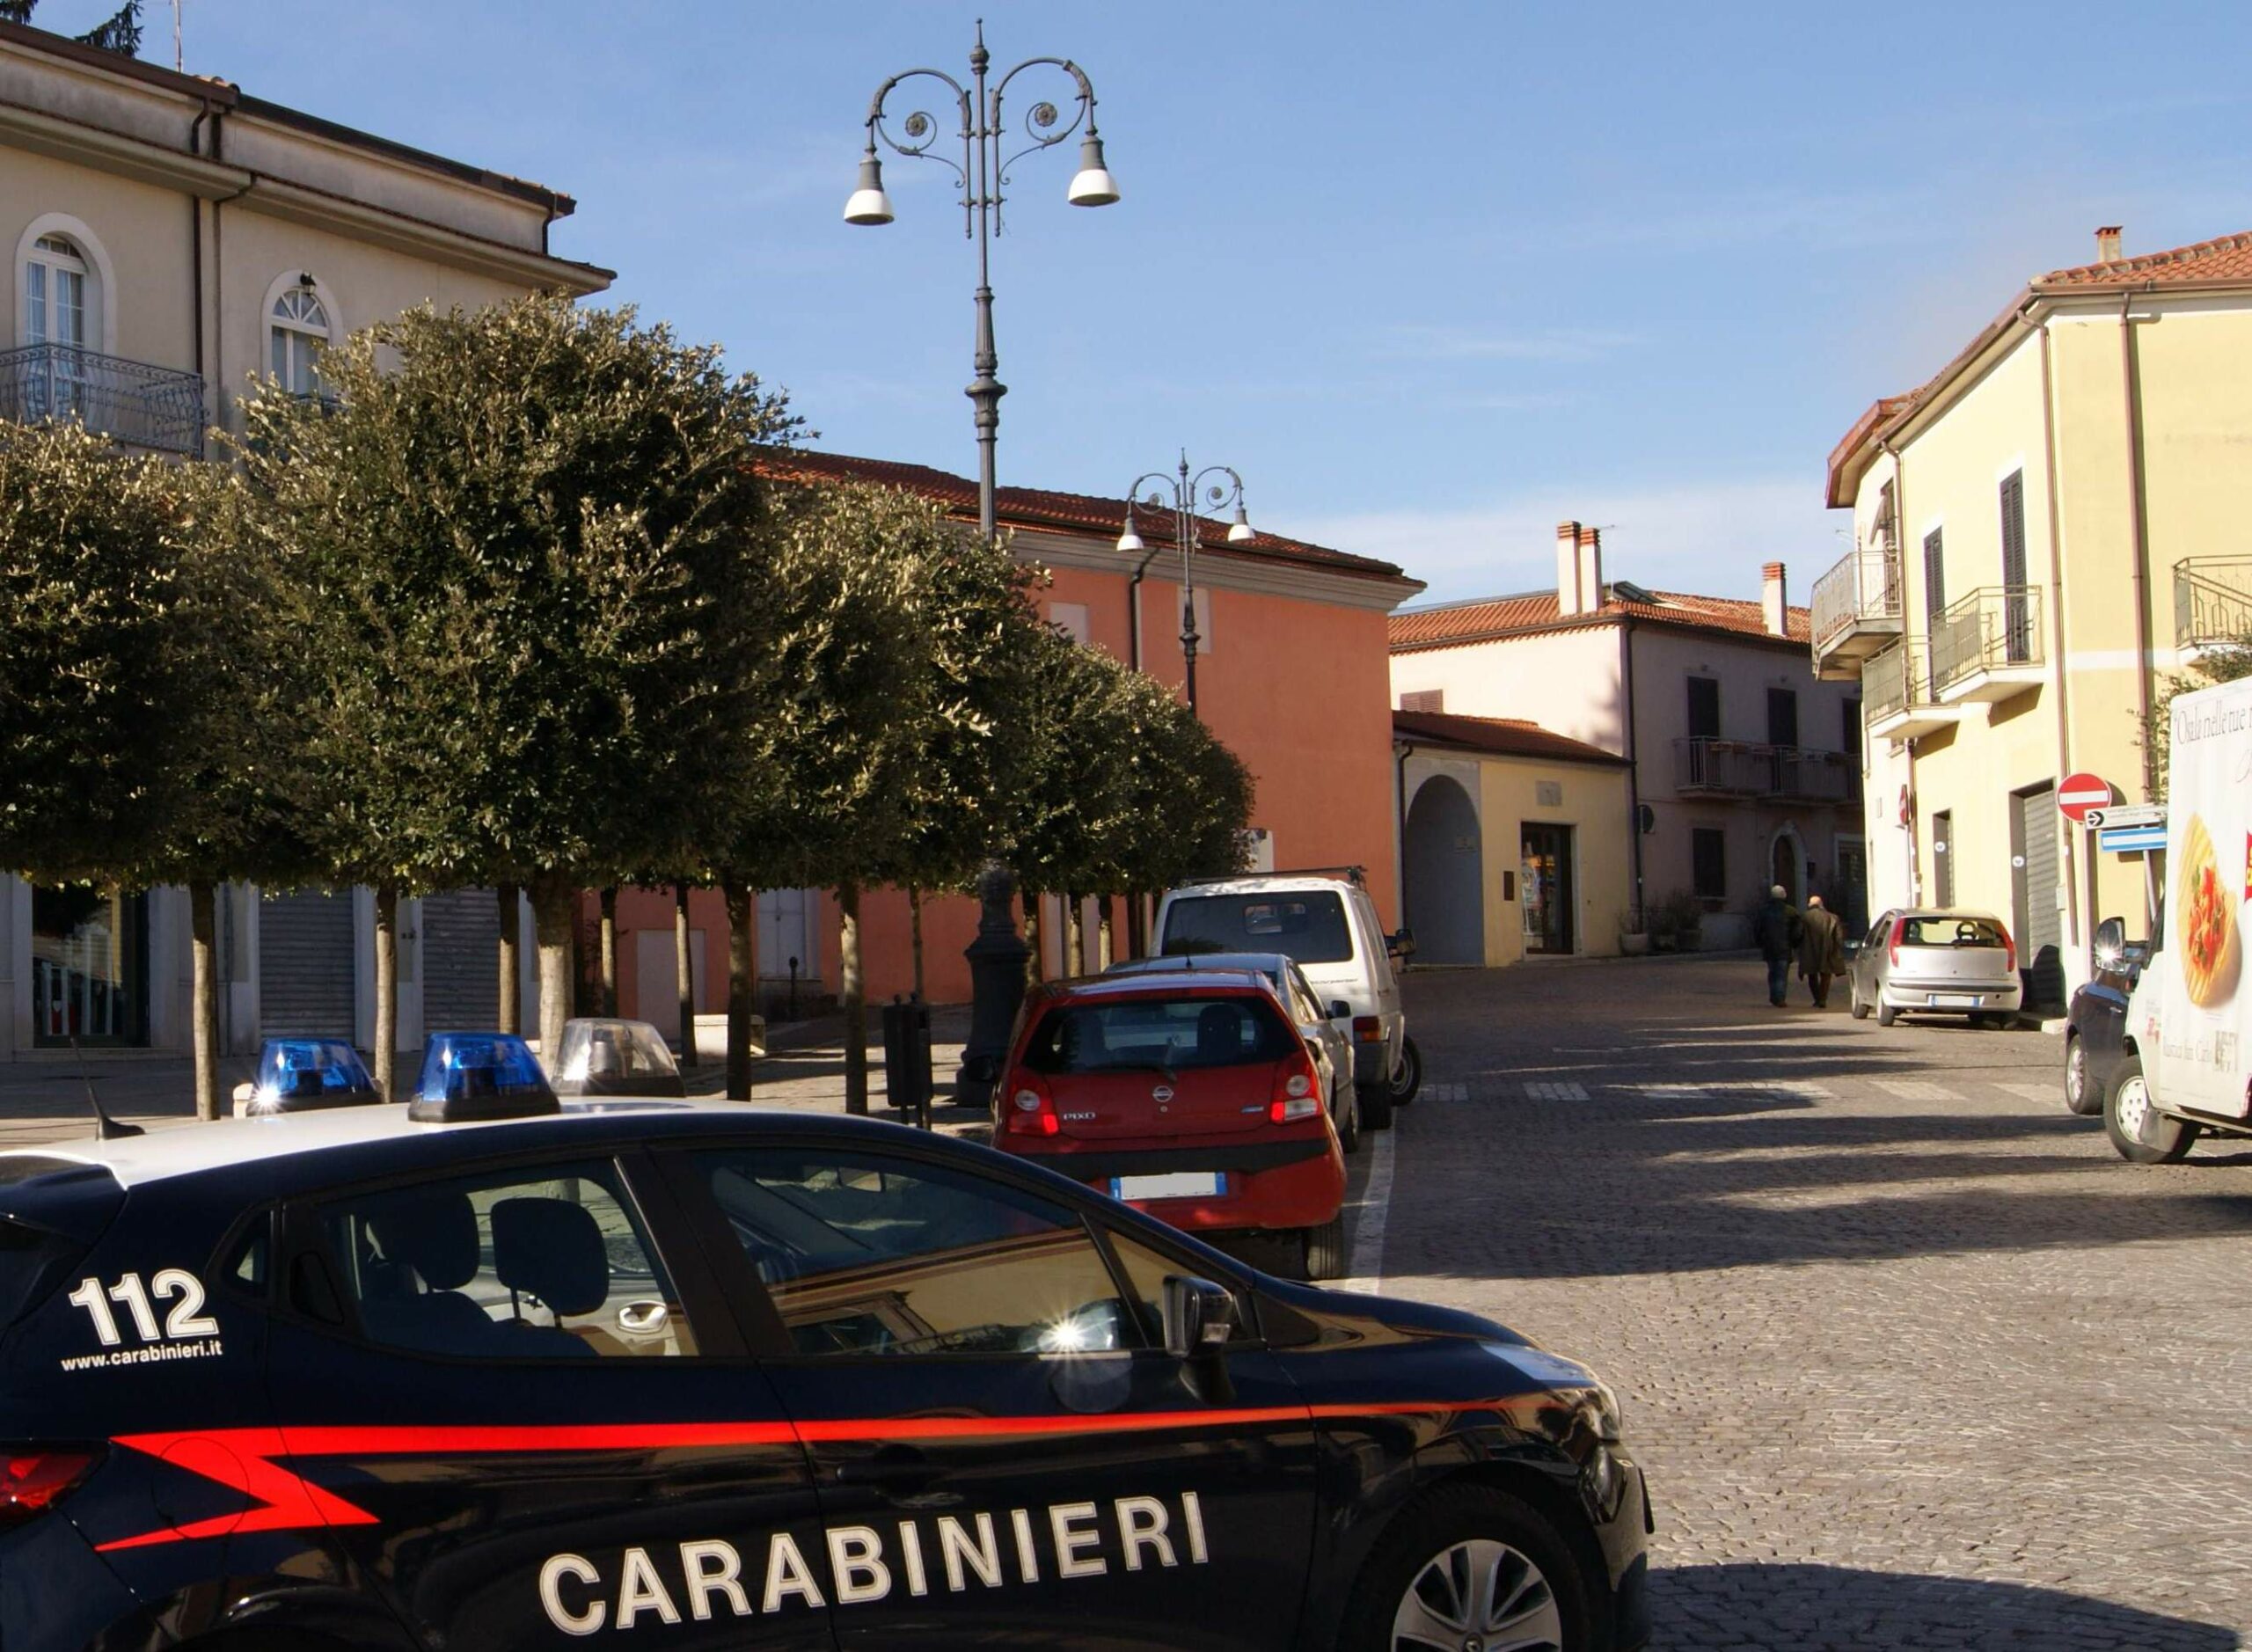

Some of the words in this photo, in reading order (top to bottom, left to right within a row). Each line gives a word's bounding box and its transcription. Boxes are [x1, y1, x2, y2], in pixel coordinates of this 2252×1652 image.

[1063, 1112, 1096, 1121] PIXO
[69, 1268, 220, 1346] 112
[60, 1340, 223, 1371] www.carabinieri.it
[538, 1491, 1209, 1637] CARABINIERI
